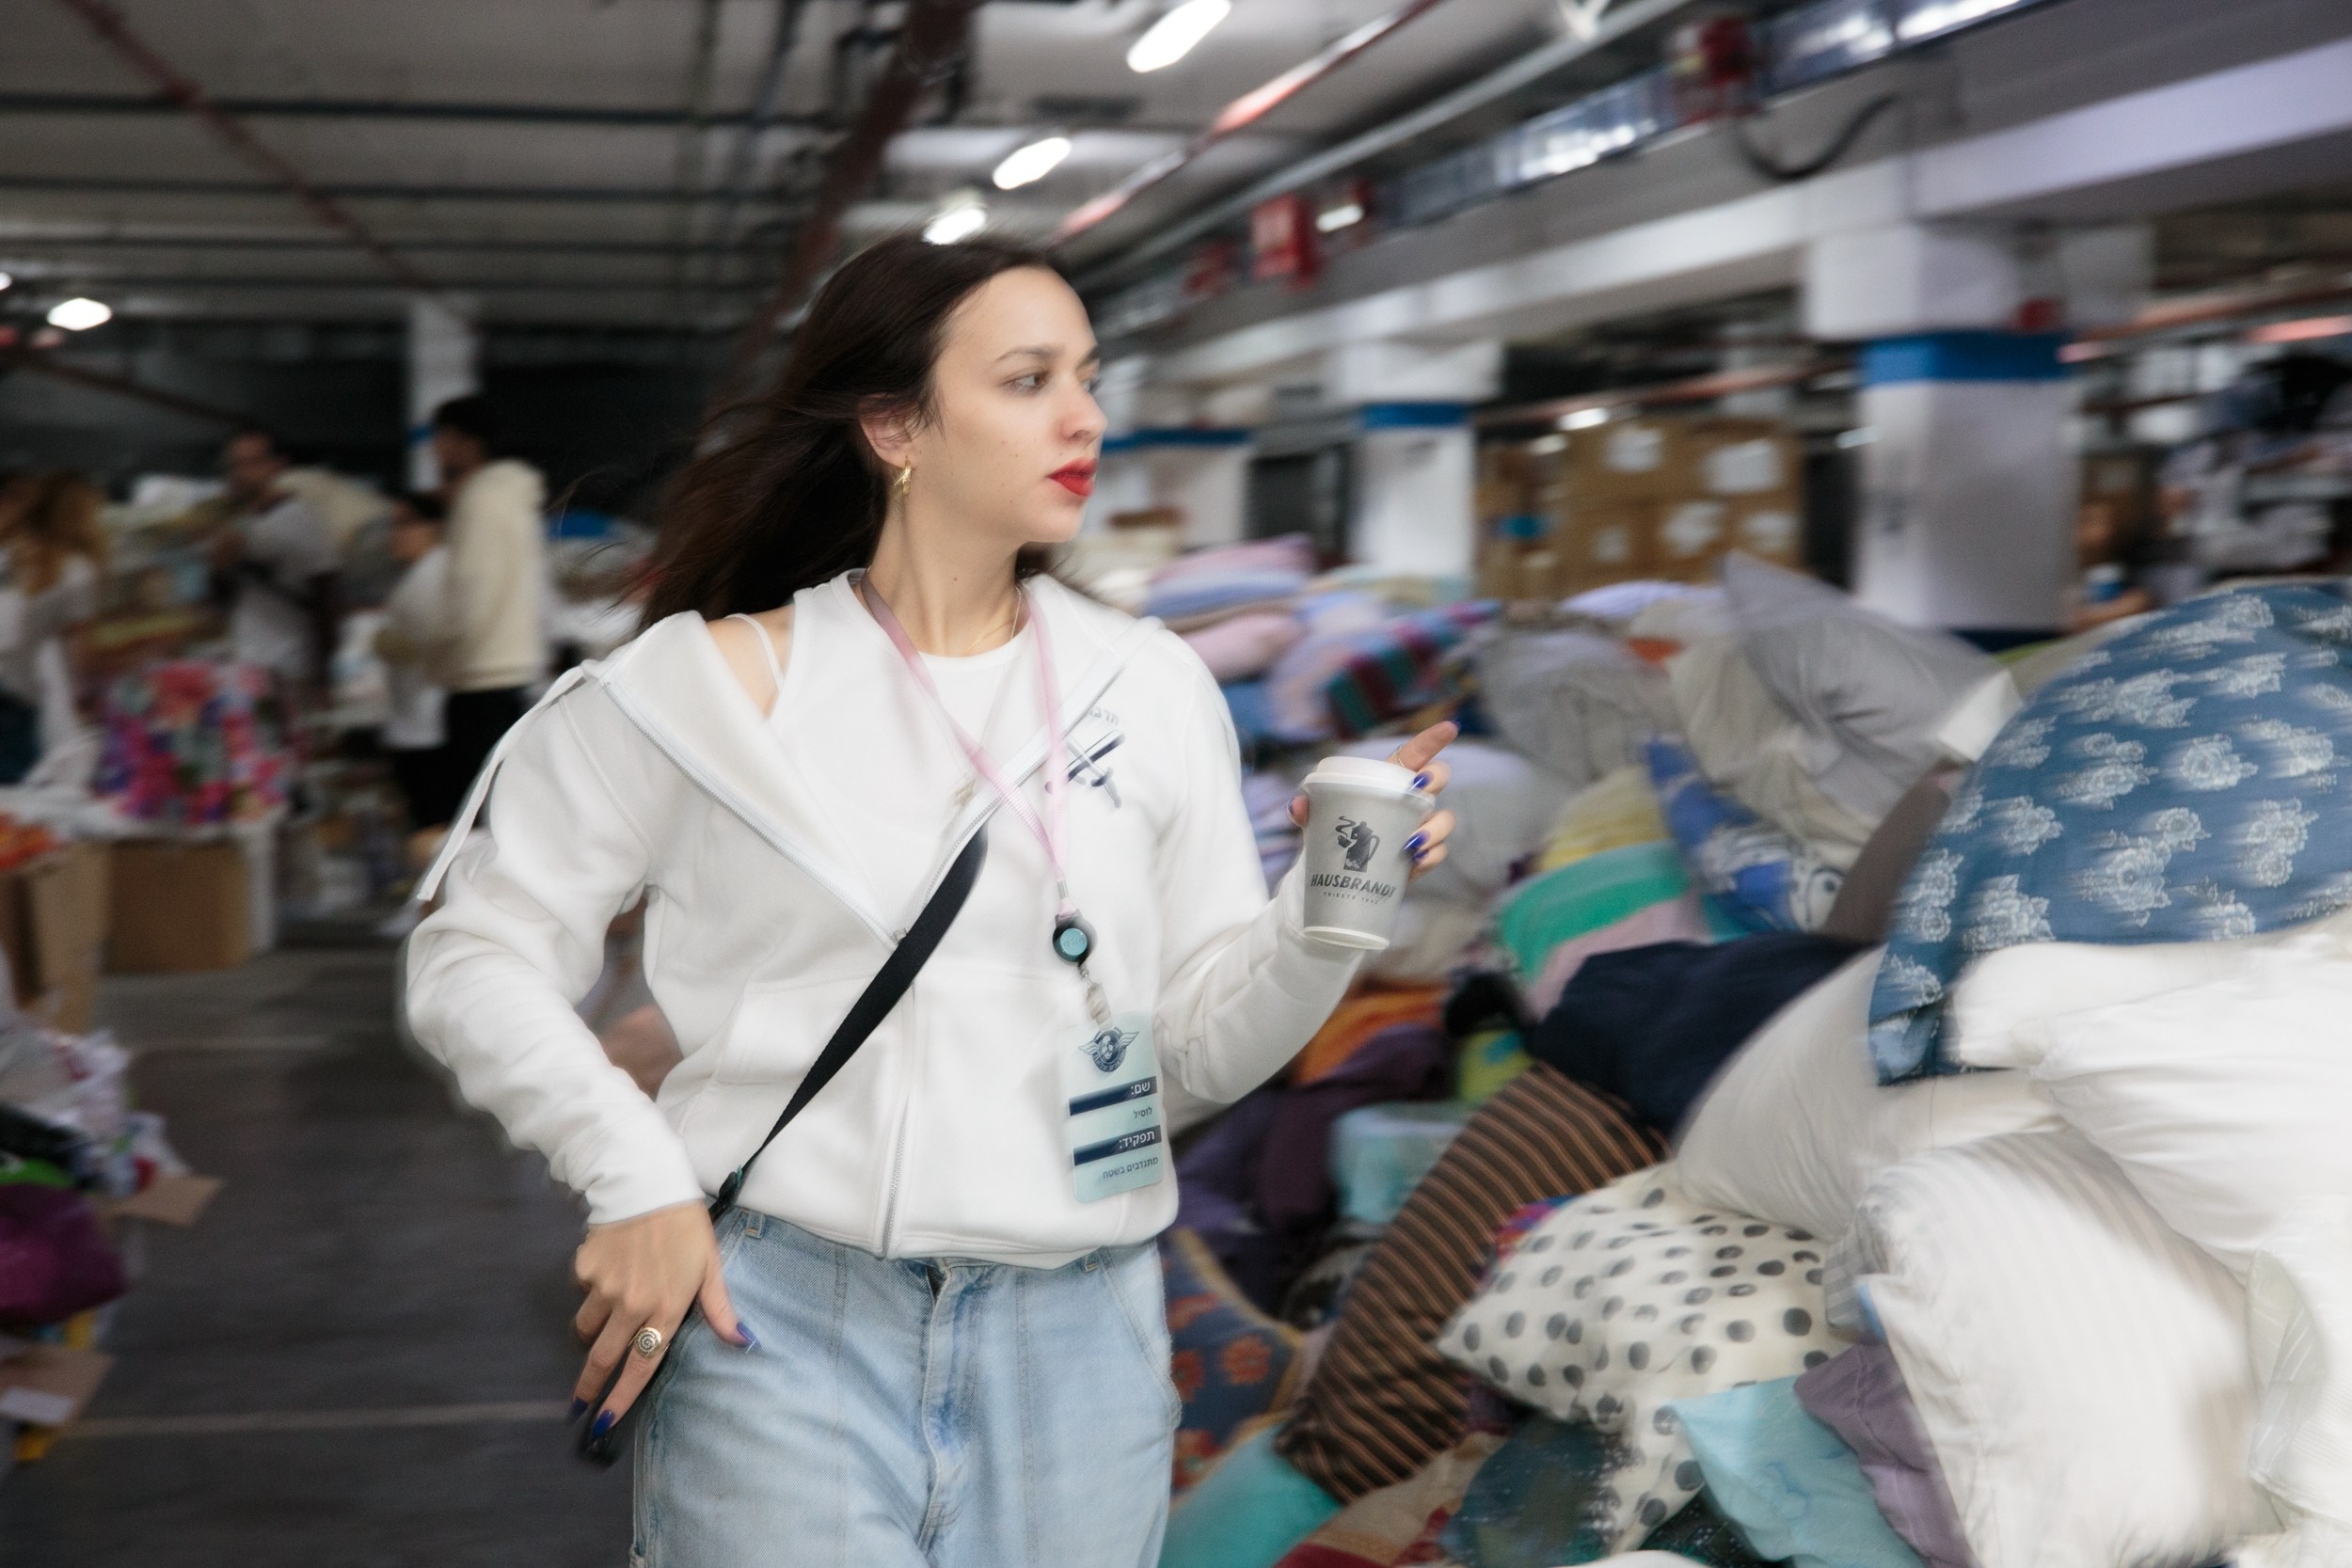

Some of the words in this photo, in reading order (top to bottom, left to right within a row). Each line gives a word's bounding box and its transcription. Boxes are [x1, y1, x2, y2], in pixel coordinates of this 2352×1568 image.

[1089, 706, 1119, 725] חרבו
[1311, 874, 1397, 897] HAUSBRANDT
[1324, 892, 1356, 900] TRIESTE
[1131, 1082, 1151, 1095] שם:
[1119, 1131, 1155, 1148] תפקיד:
[1127, 1157, 1158, 1172] מתנדבים
[1103, 1166, 1125, 1179] בשטח
